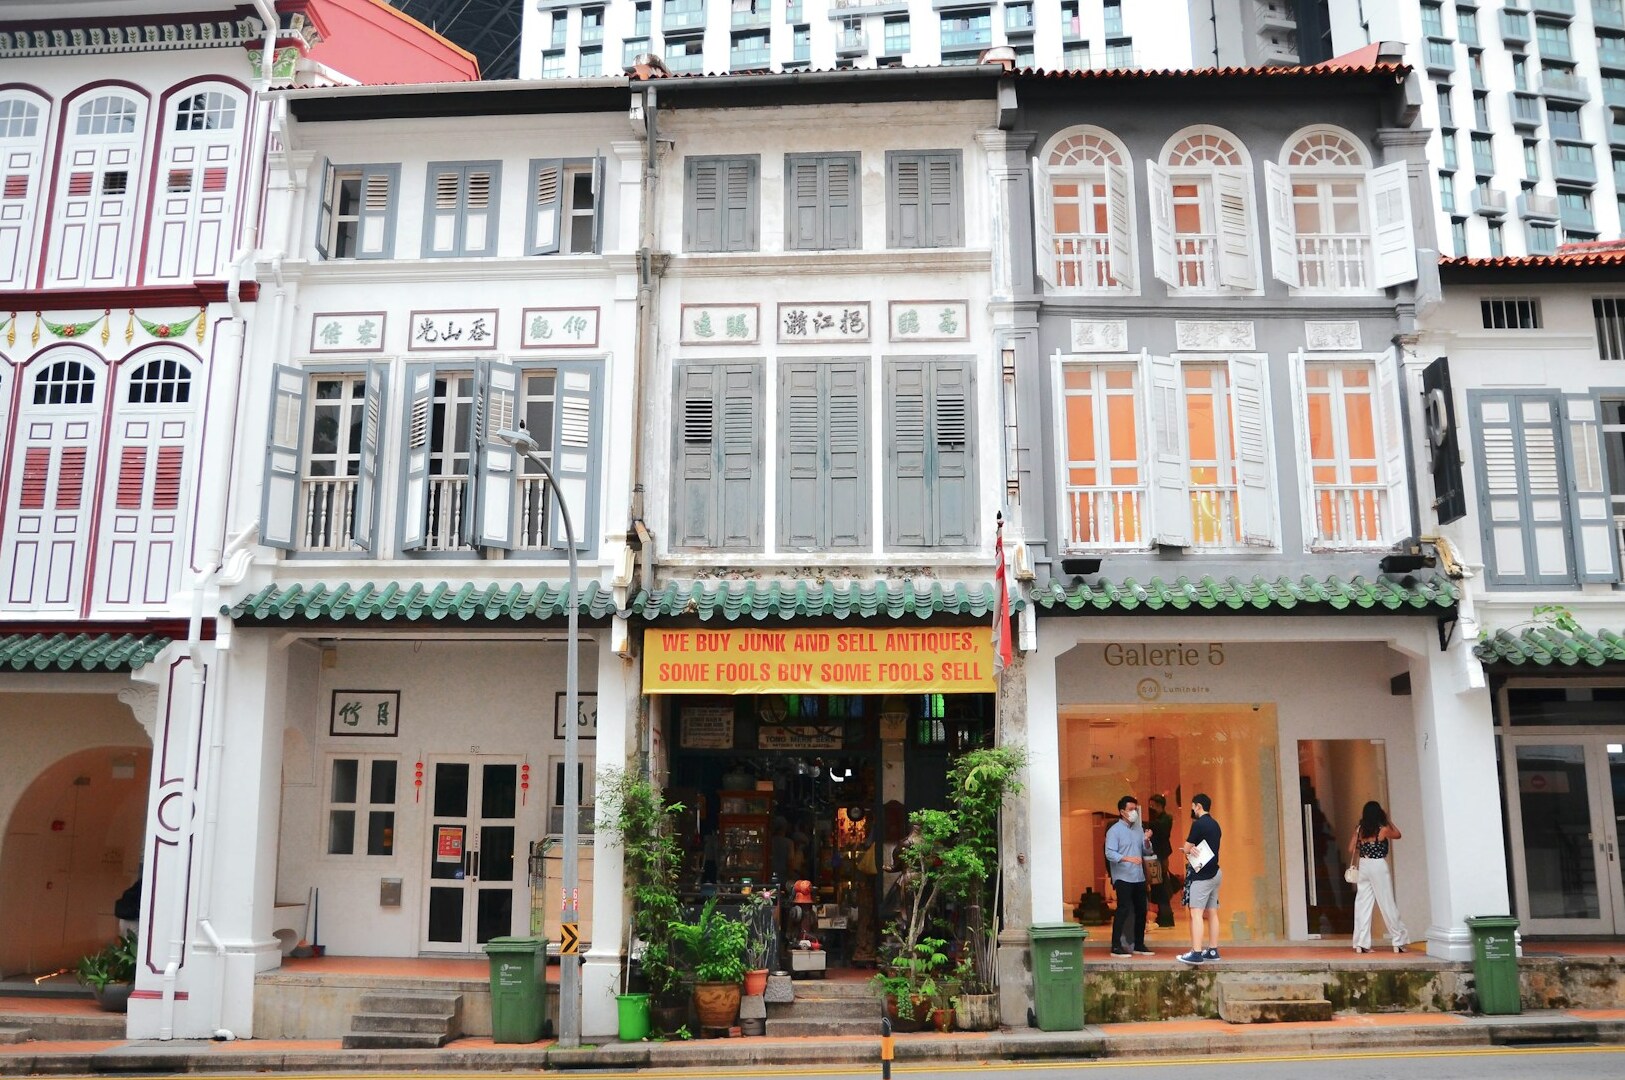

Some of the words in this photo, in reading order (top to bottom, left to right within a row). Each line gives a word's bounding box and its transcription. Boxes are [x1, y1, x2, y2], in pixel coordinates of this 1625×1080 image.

[662, 634, 689, 652] WE
[696, 634, 731, 652] BUY
[738, 634, 786, 652] JUNK
[794, 634, 830, 652] AND
[837, 633, 878, 652] SELL
[886, 632, 978, 654] ANTIQUES,
[1104, 642, 1200, 666] Galerie
[1208, 642, 1224, 666] 5
[660, 663, 710, 682] SOME
[716, 663, 771, 682] FOOLS
[778, 664, 814, 682] BUY
[820, 663, 872, 682] SOME
[878, 662, 934, 682] FOOLS
[942, 662, 982, 681] SELL
